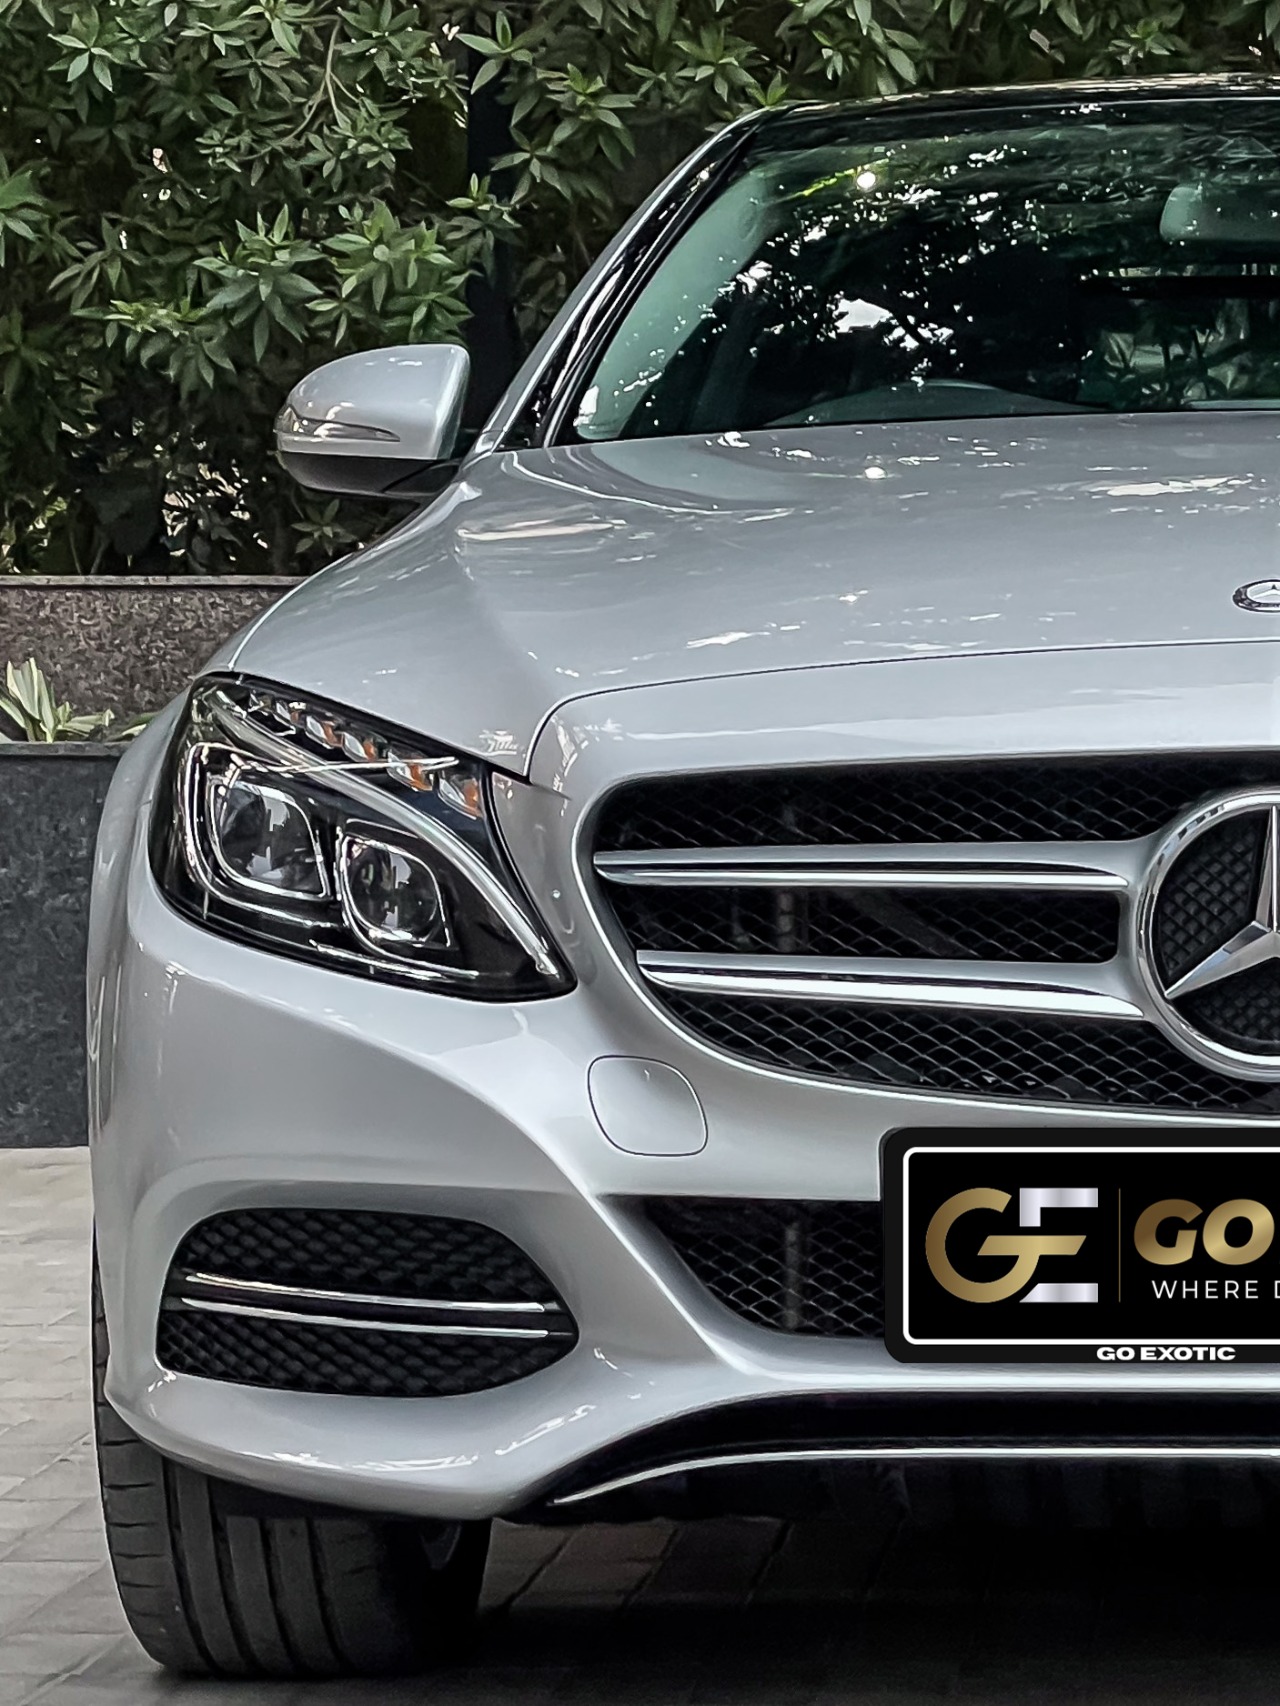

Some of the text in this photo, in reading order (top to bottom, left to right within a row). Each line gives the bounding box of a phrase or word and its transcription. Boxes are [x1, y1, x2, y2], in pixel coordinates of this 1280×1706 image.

[1152, 1280, 1259, 1299] WHERE
[1097, 1347, 1136, 1361] GO
[1140, 1347, 1236, 1361] EXOTIC
